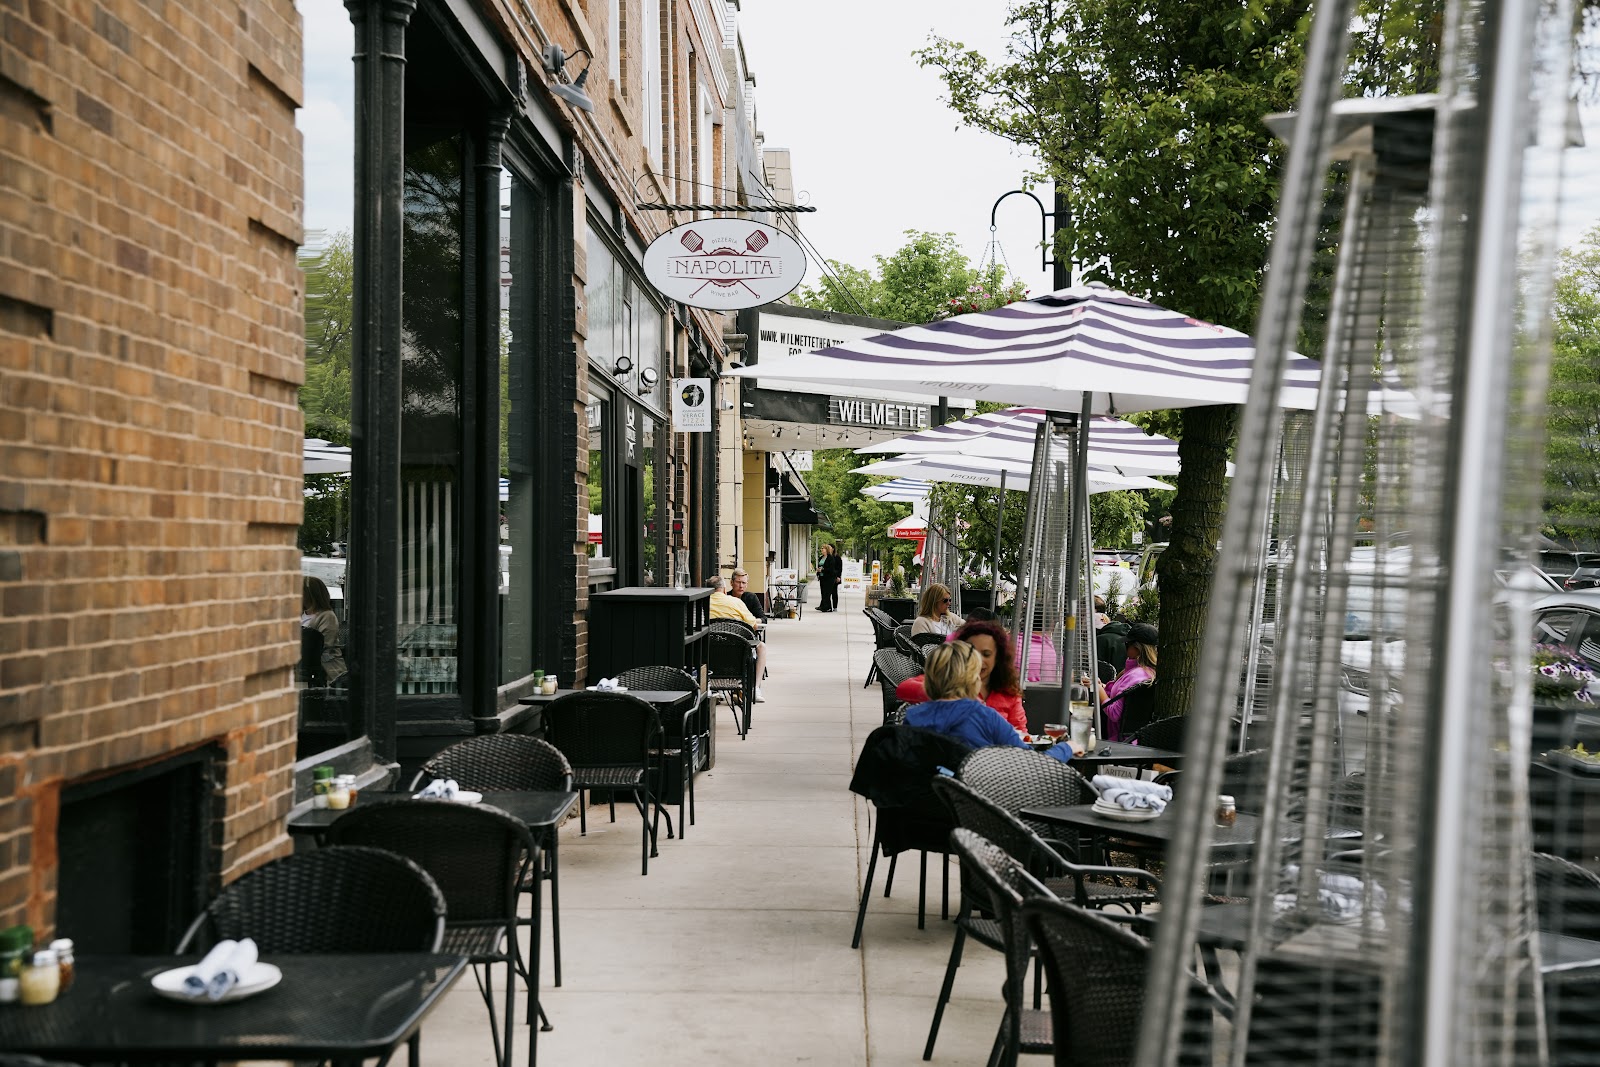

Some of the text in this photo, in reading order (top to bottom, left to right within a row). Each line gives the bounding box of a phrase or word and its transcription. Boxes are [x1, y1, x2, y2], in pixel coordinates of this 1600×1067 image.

[711, 237, 738, 245] PIZZERIA
[675, 260, 774, 275] NAPOLITA
[710, 289, 726, 297] WINE
[838, 399, 927, 428] WILMETTE
[1105, 768, 1133, 779] ARITZIA
